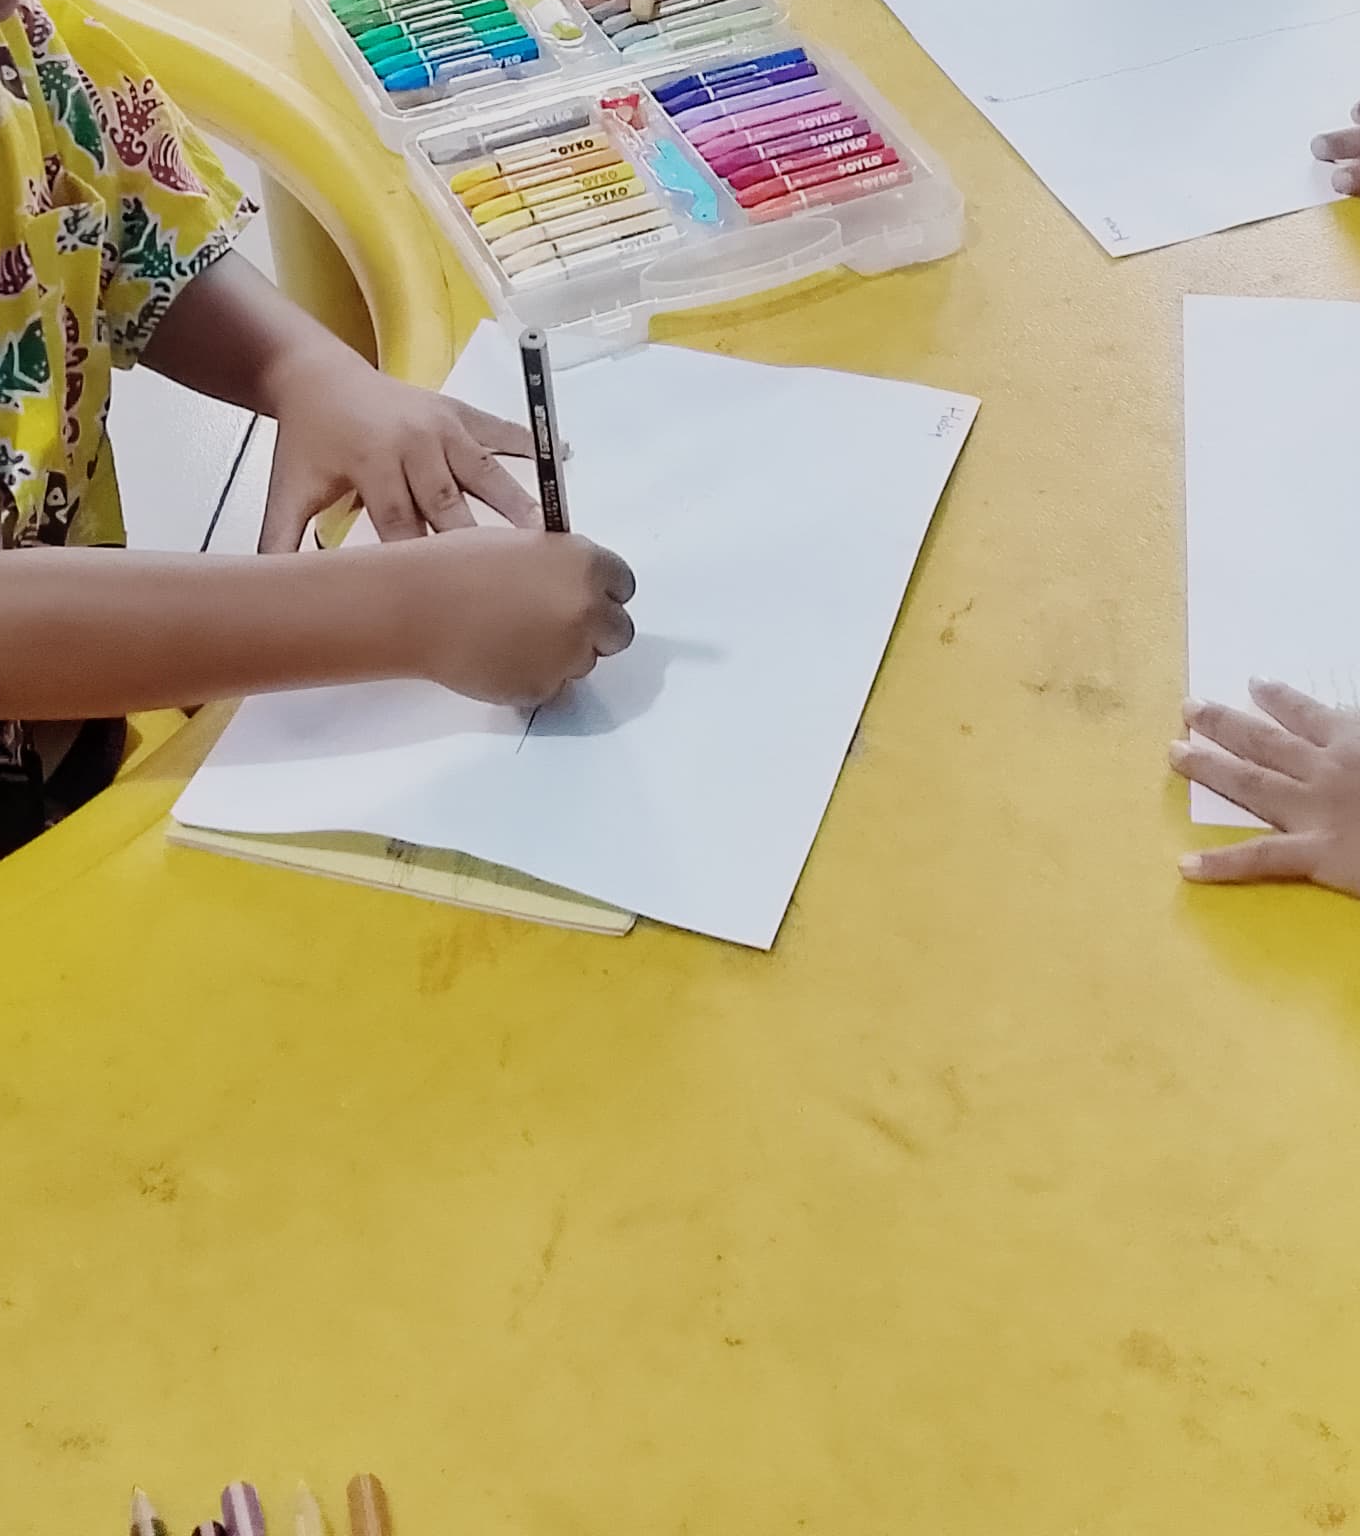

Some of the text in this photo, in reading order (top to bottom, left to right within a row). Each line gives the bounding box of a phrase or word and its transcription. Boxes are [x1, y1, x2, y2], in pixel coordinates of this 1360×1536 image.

[797, 111, 840, 130] JOYKO
[810, 126, 854, 146] JOYKO
[823, 137, 868, 158] JOYKO
[837, 154, 882, 175] JOYKO
